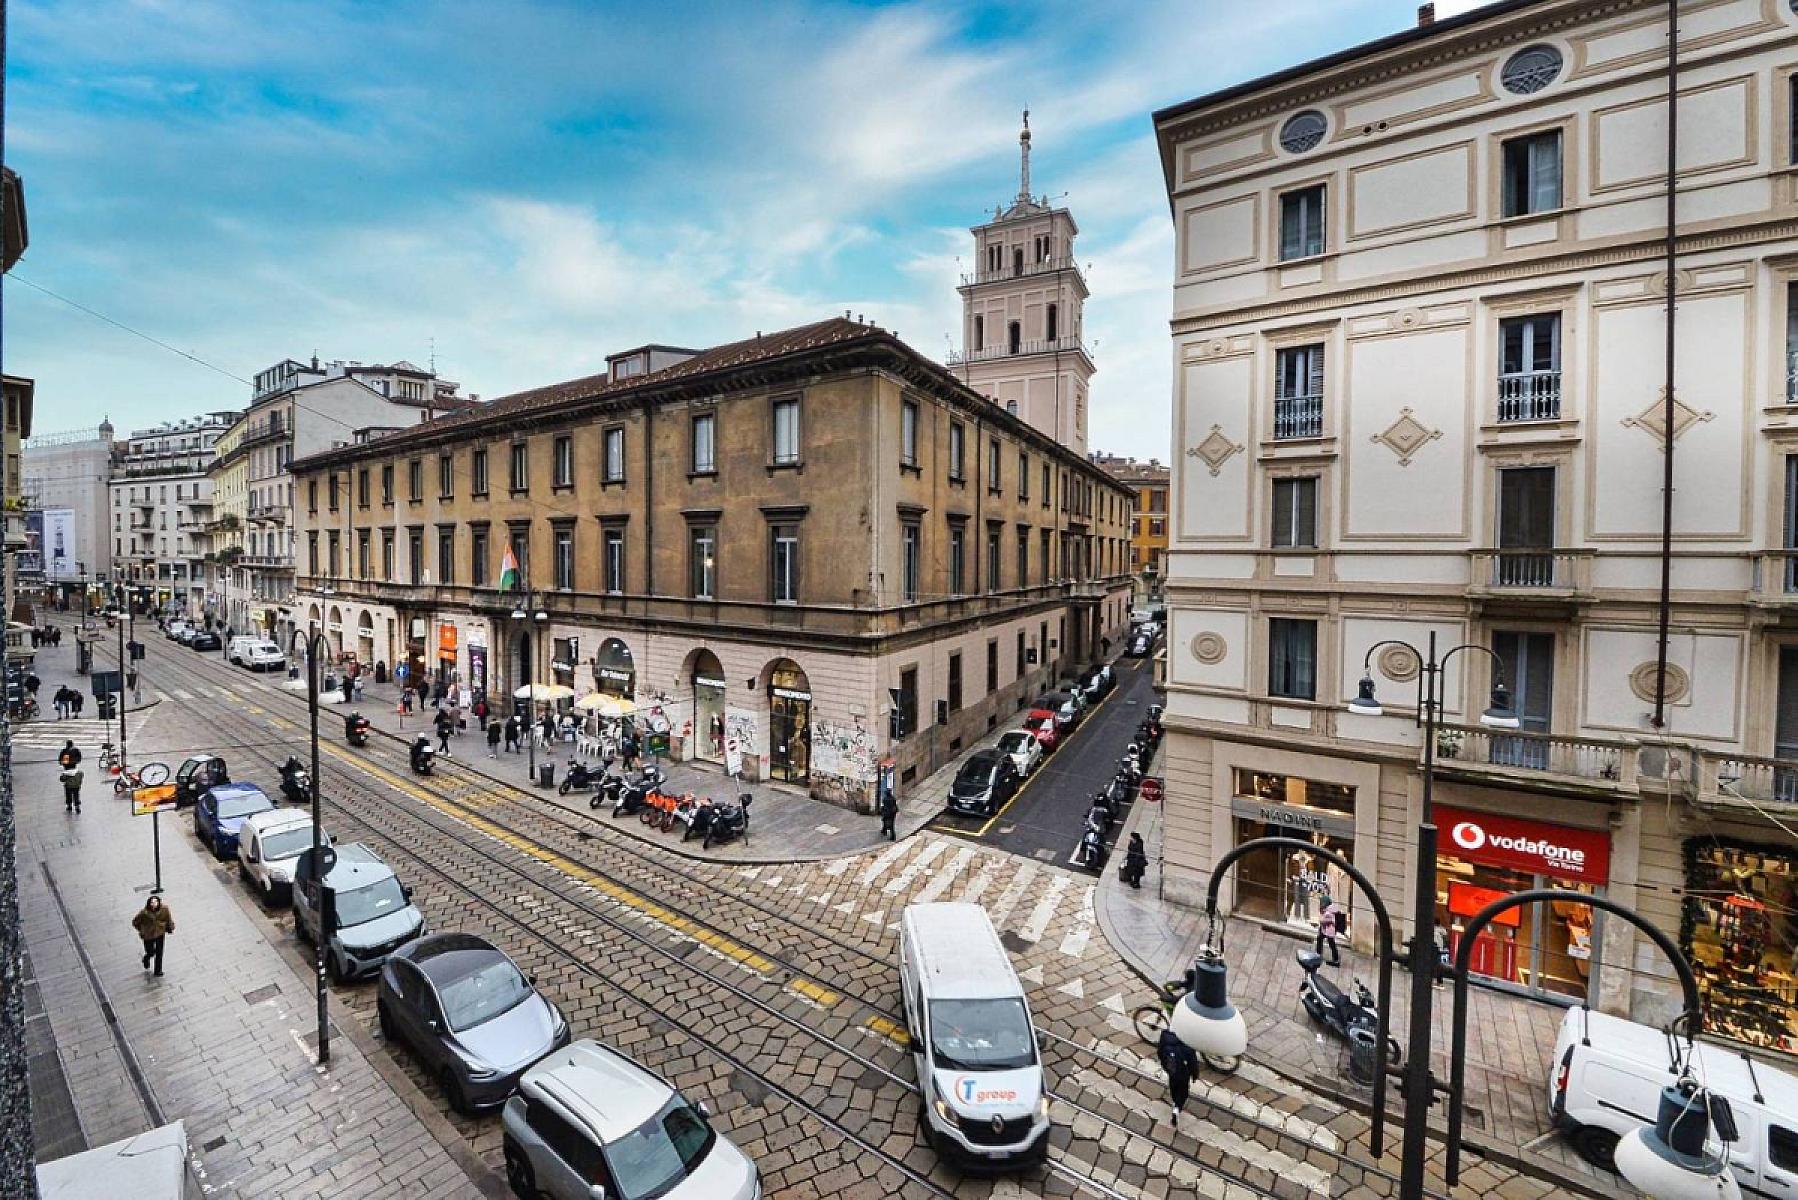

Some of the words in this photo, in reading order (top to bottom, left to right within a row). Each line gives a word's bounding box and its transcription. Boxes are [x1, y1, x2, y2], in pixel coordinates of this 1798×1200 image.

[1260, 807, 1322, 829] NADINE
[1488, 834, 1585, 861] vodafone
[976, 1089, 1017, 1102] group
